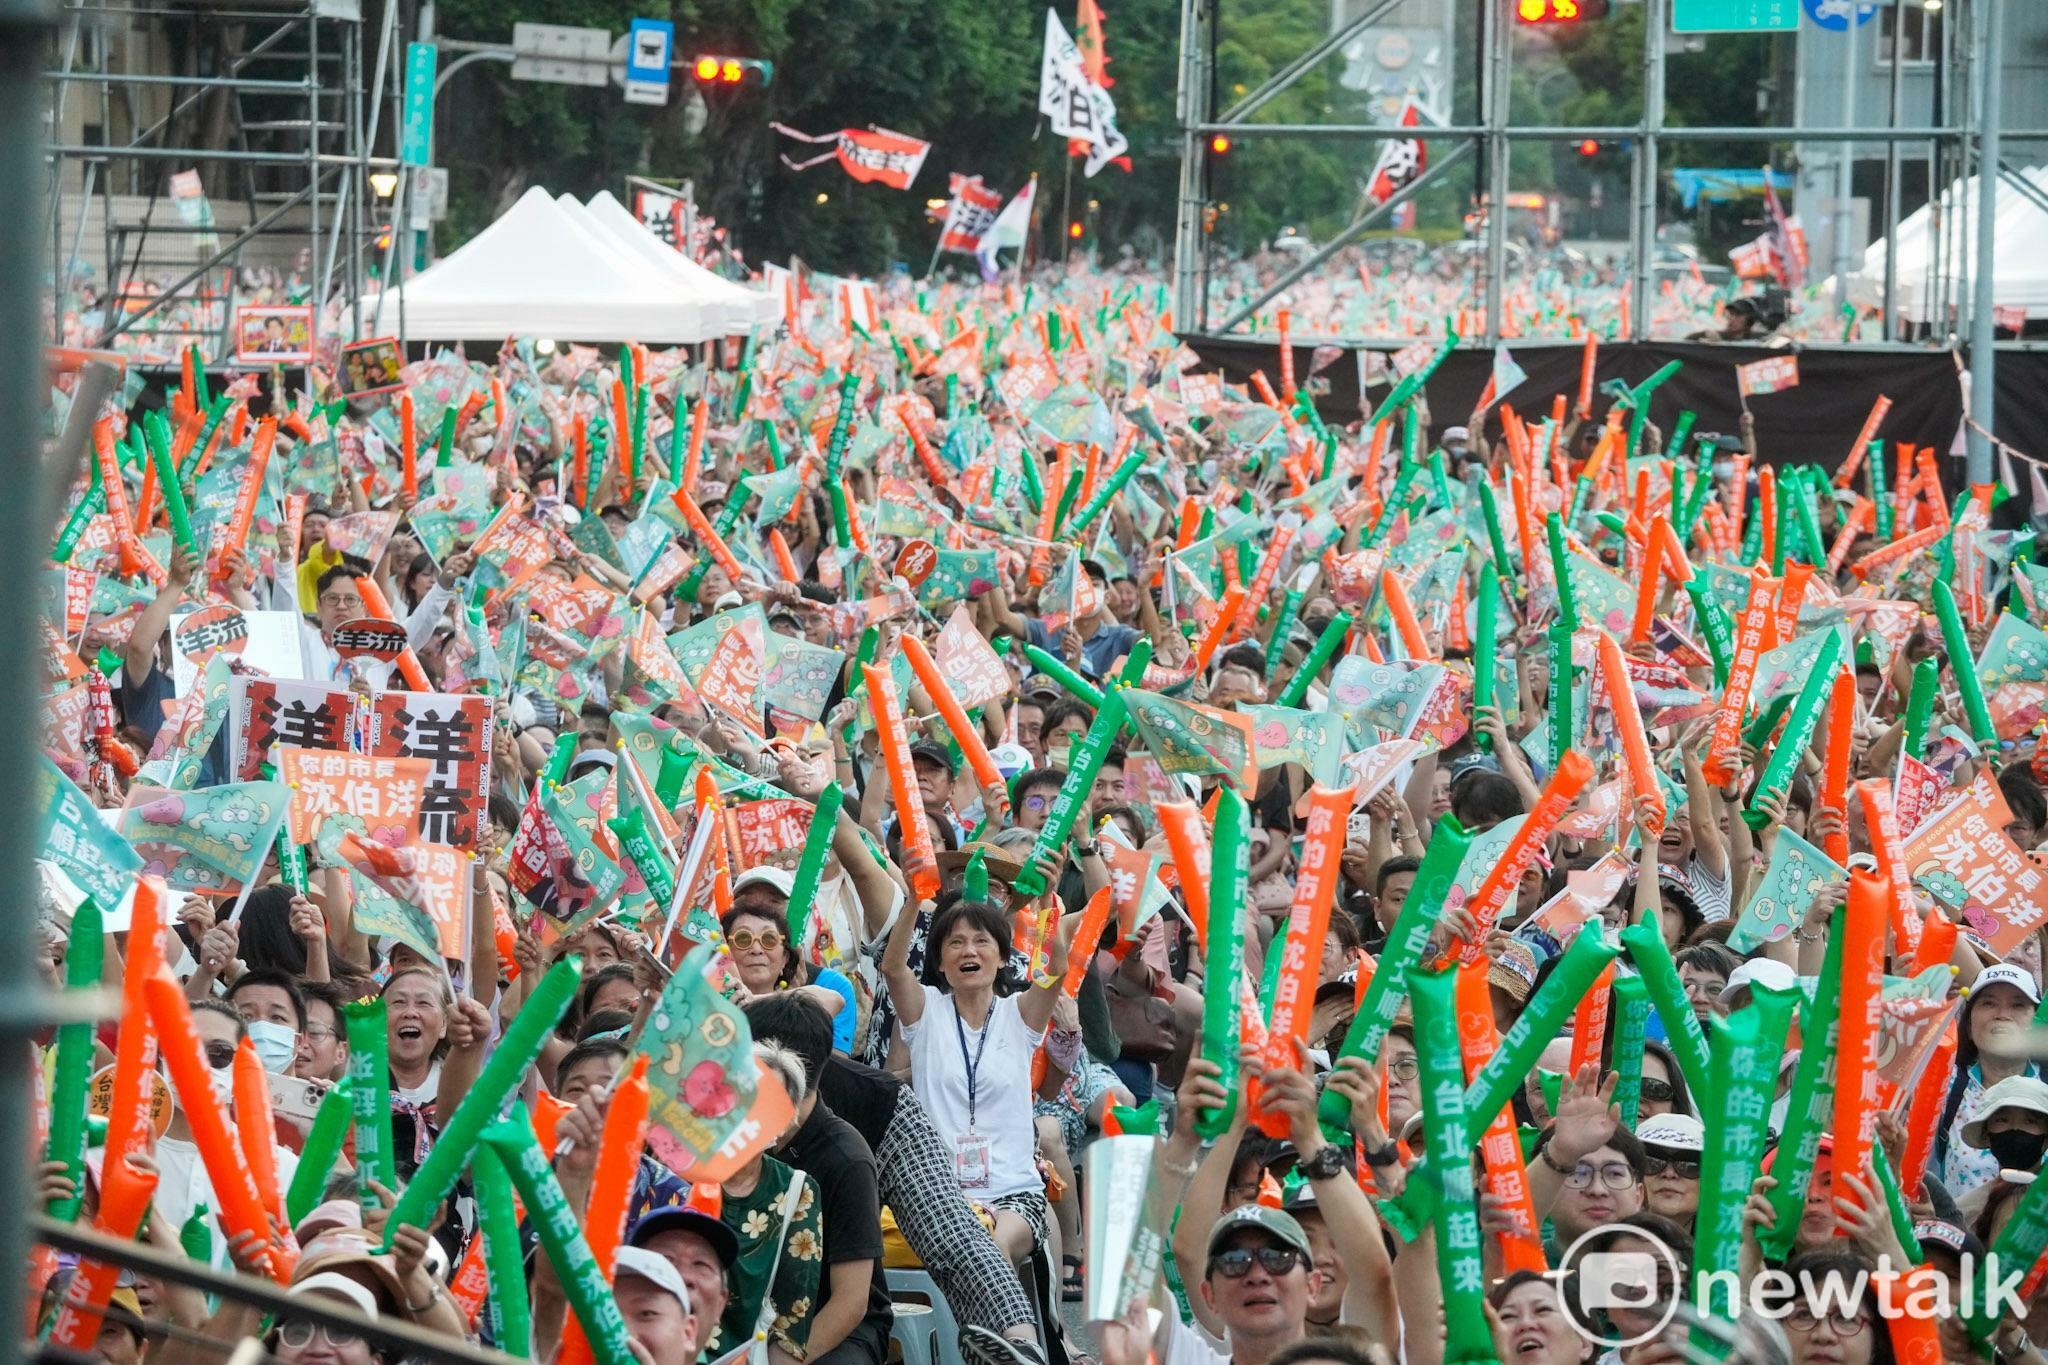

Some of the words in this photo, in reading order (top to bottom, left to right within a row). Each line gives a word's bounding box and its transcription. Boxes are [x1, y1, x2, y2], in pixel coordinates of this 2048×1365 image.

[176, 613, 249, 656] 洋流
[333, 629, 409, 652] 洋流
[1719, 587, 1773, 728] 你的市長沈伯洋
[297, 755, 397, 780] 你的市長
[300, 777, 418, 818] 沈伯洋
[1033, 748, 1092, 863] 台北順起來
[1927, 826, 2046, 929] 沈伯洋
[1964, 814, 2043, 894] 你的市長
[1271, 805, 1334, 1037] 你的市長沈伯洋
[1986, 968, 2019, 980] Lynx
[1434, 1080, 1483, 1292] 台北順起來
